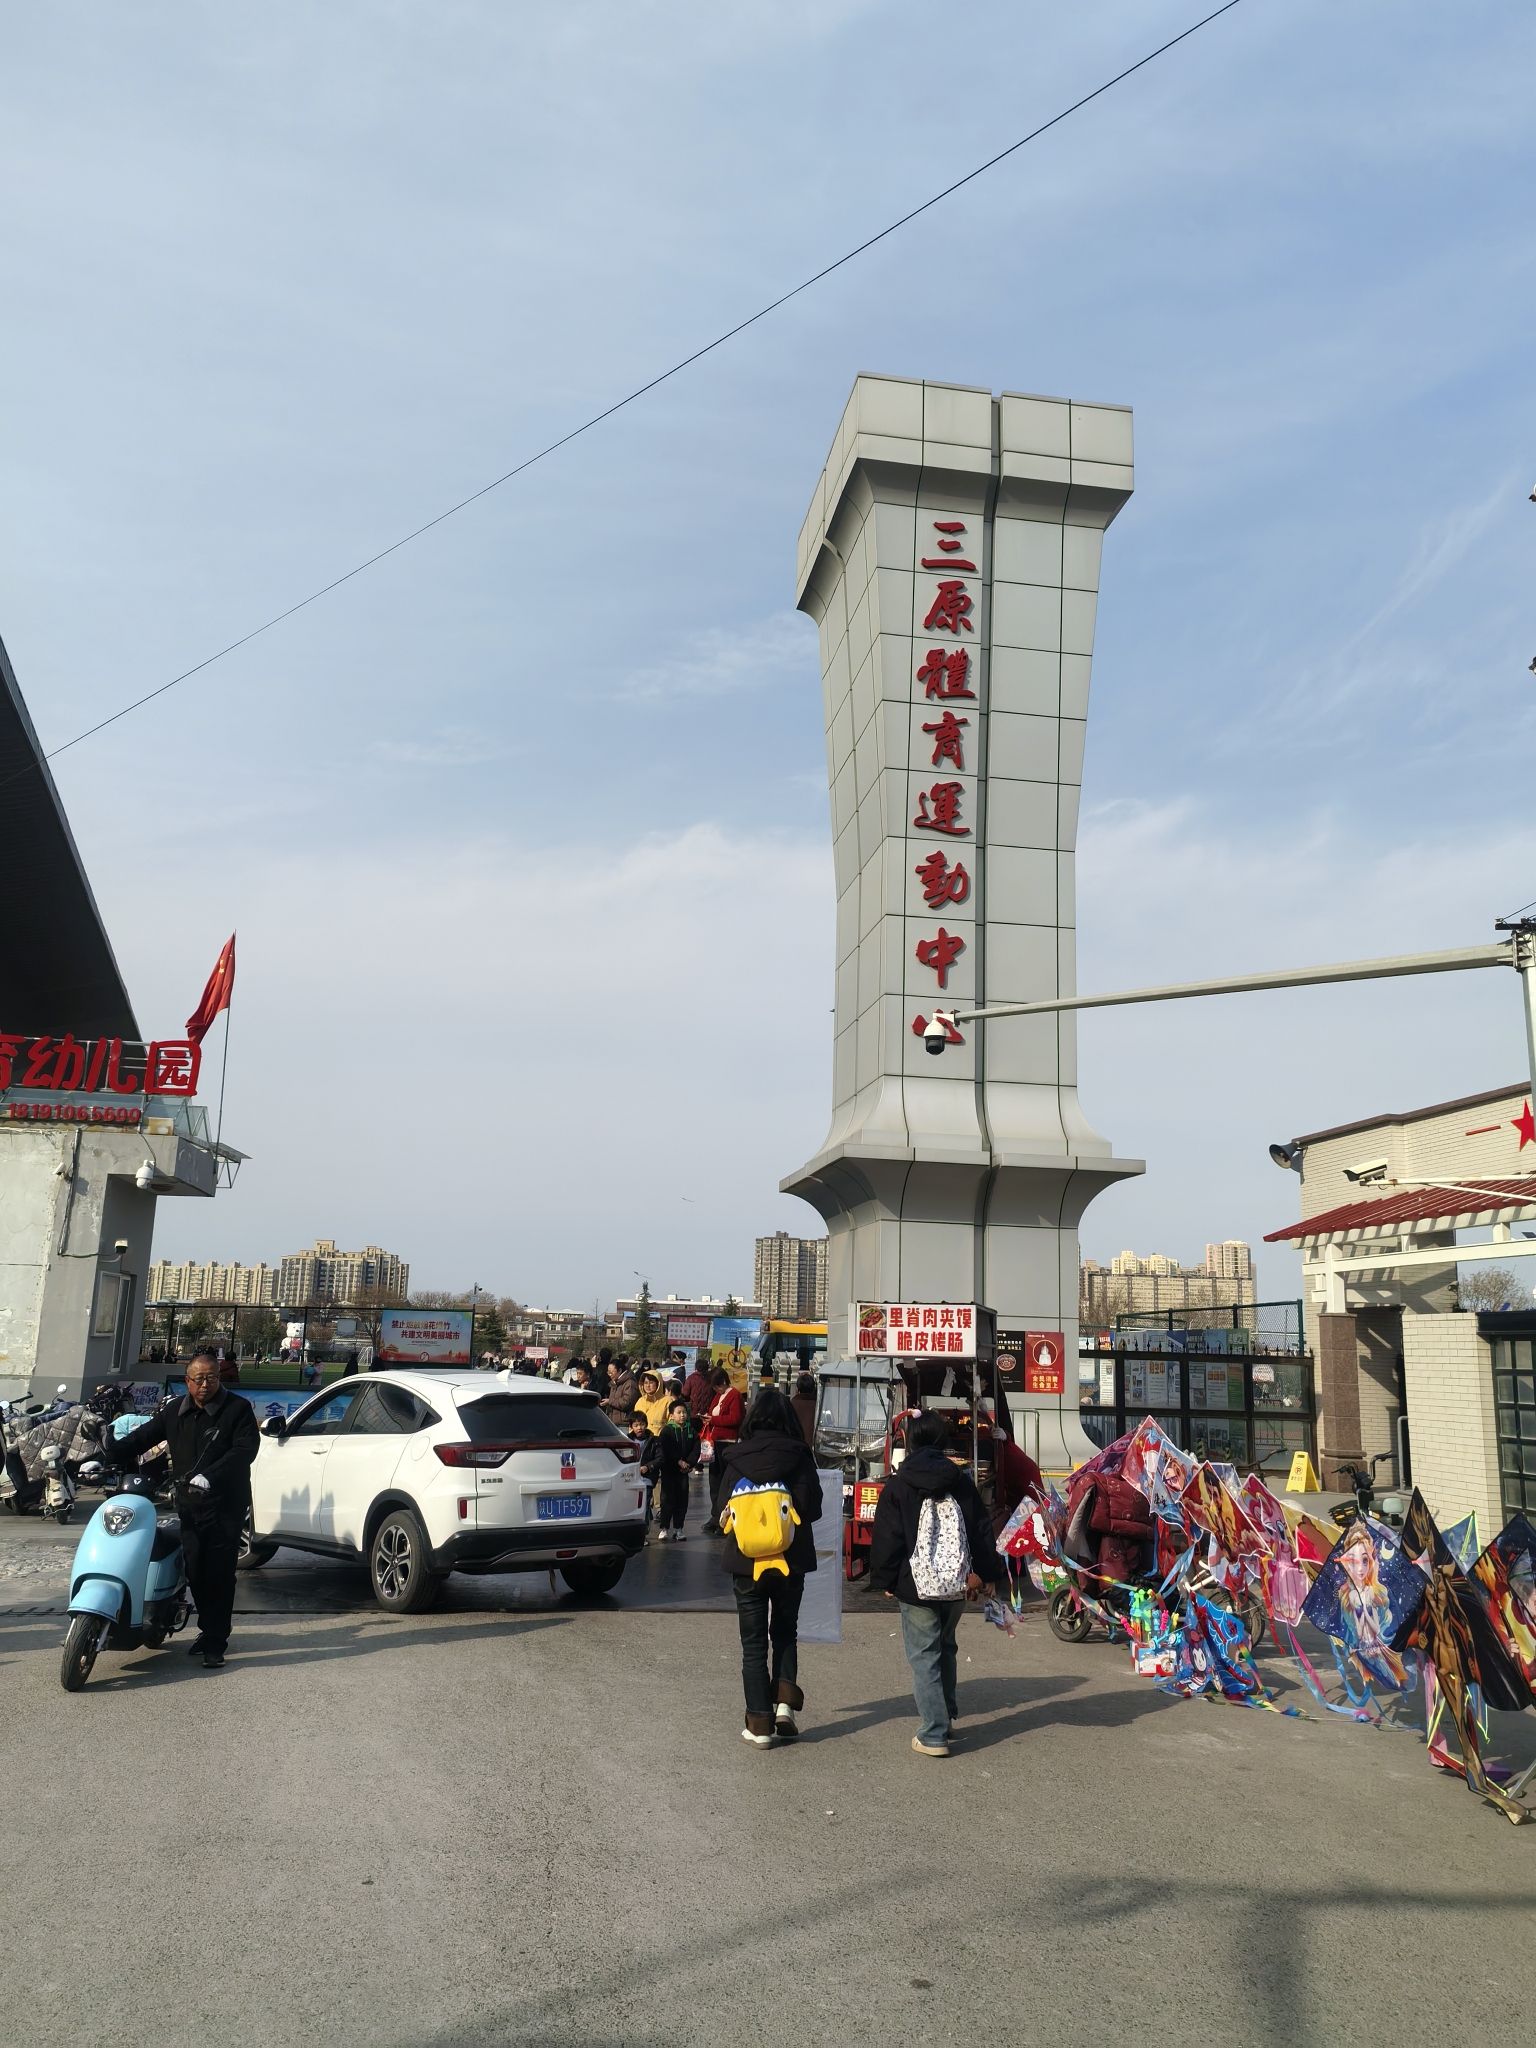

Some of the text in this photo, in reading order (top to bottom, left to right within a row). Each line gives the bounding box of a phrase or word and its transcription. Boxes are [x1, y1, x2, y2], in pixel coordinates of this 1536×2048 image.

[889, 1307, 972, 1328] 里脊肉夹馍
[897, 1331, 963, 1352] 脆皮烤肠
